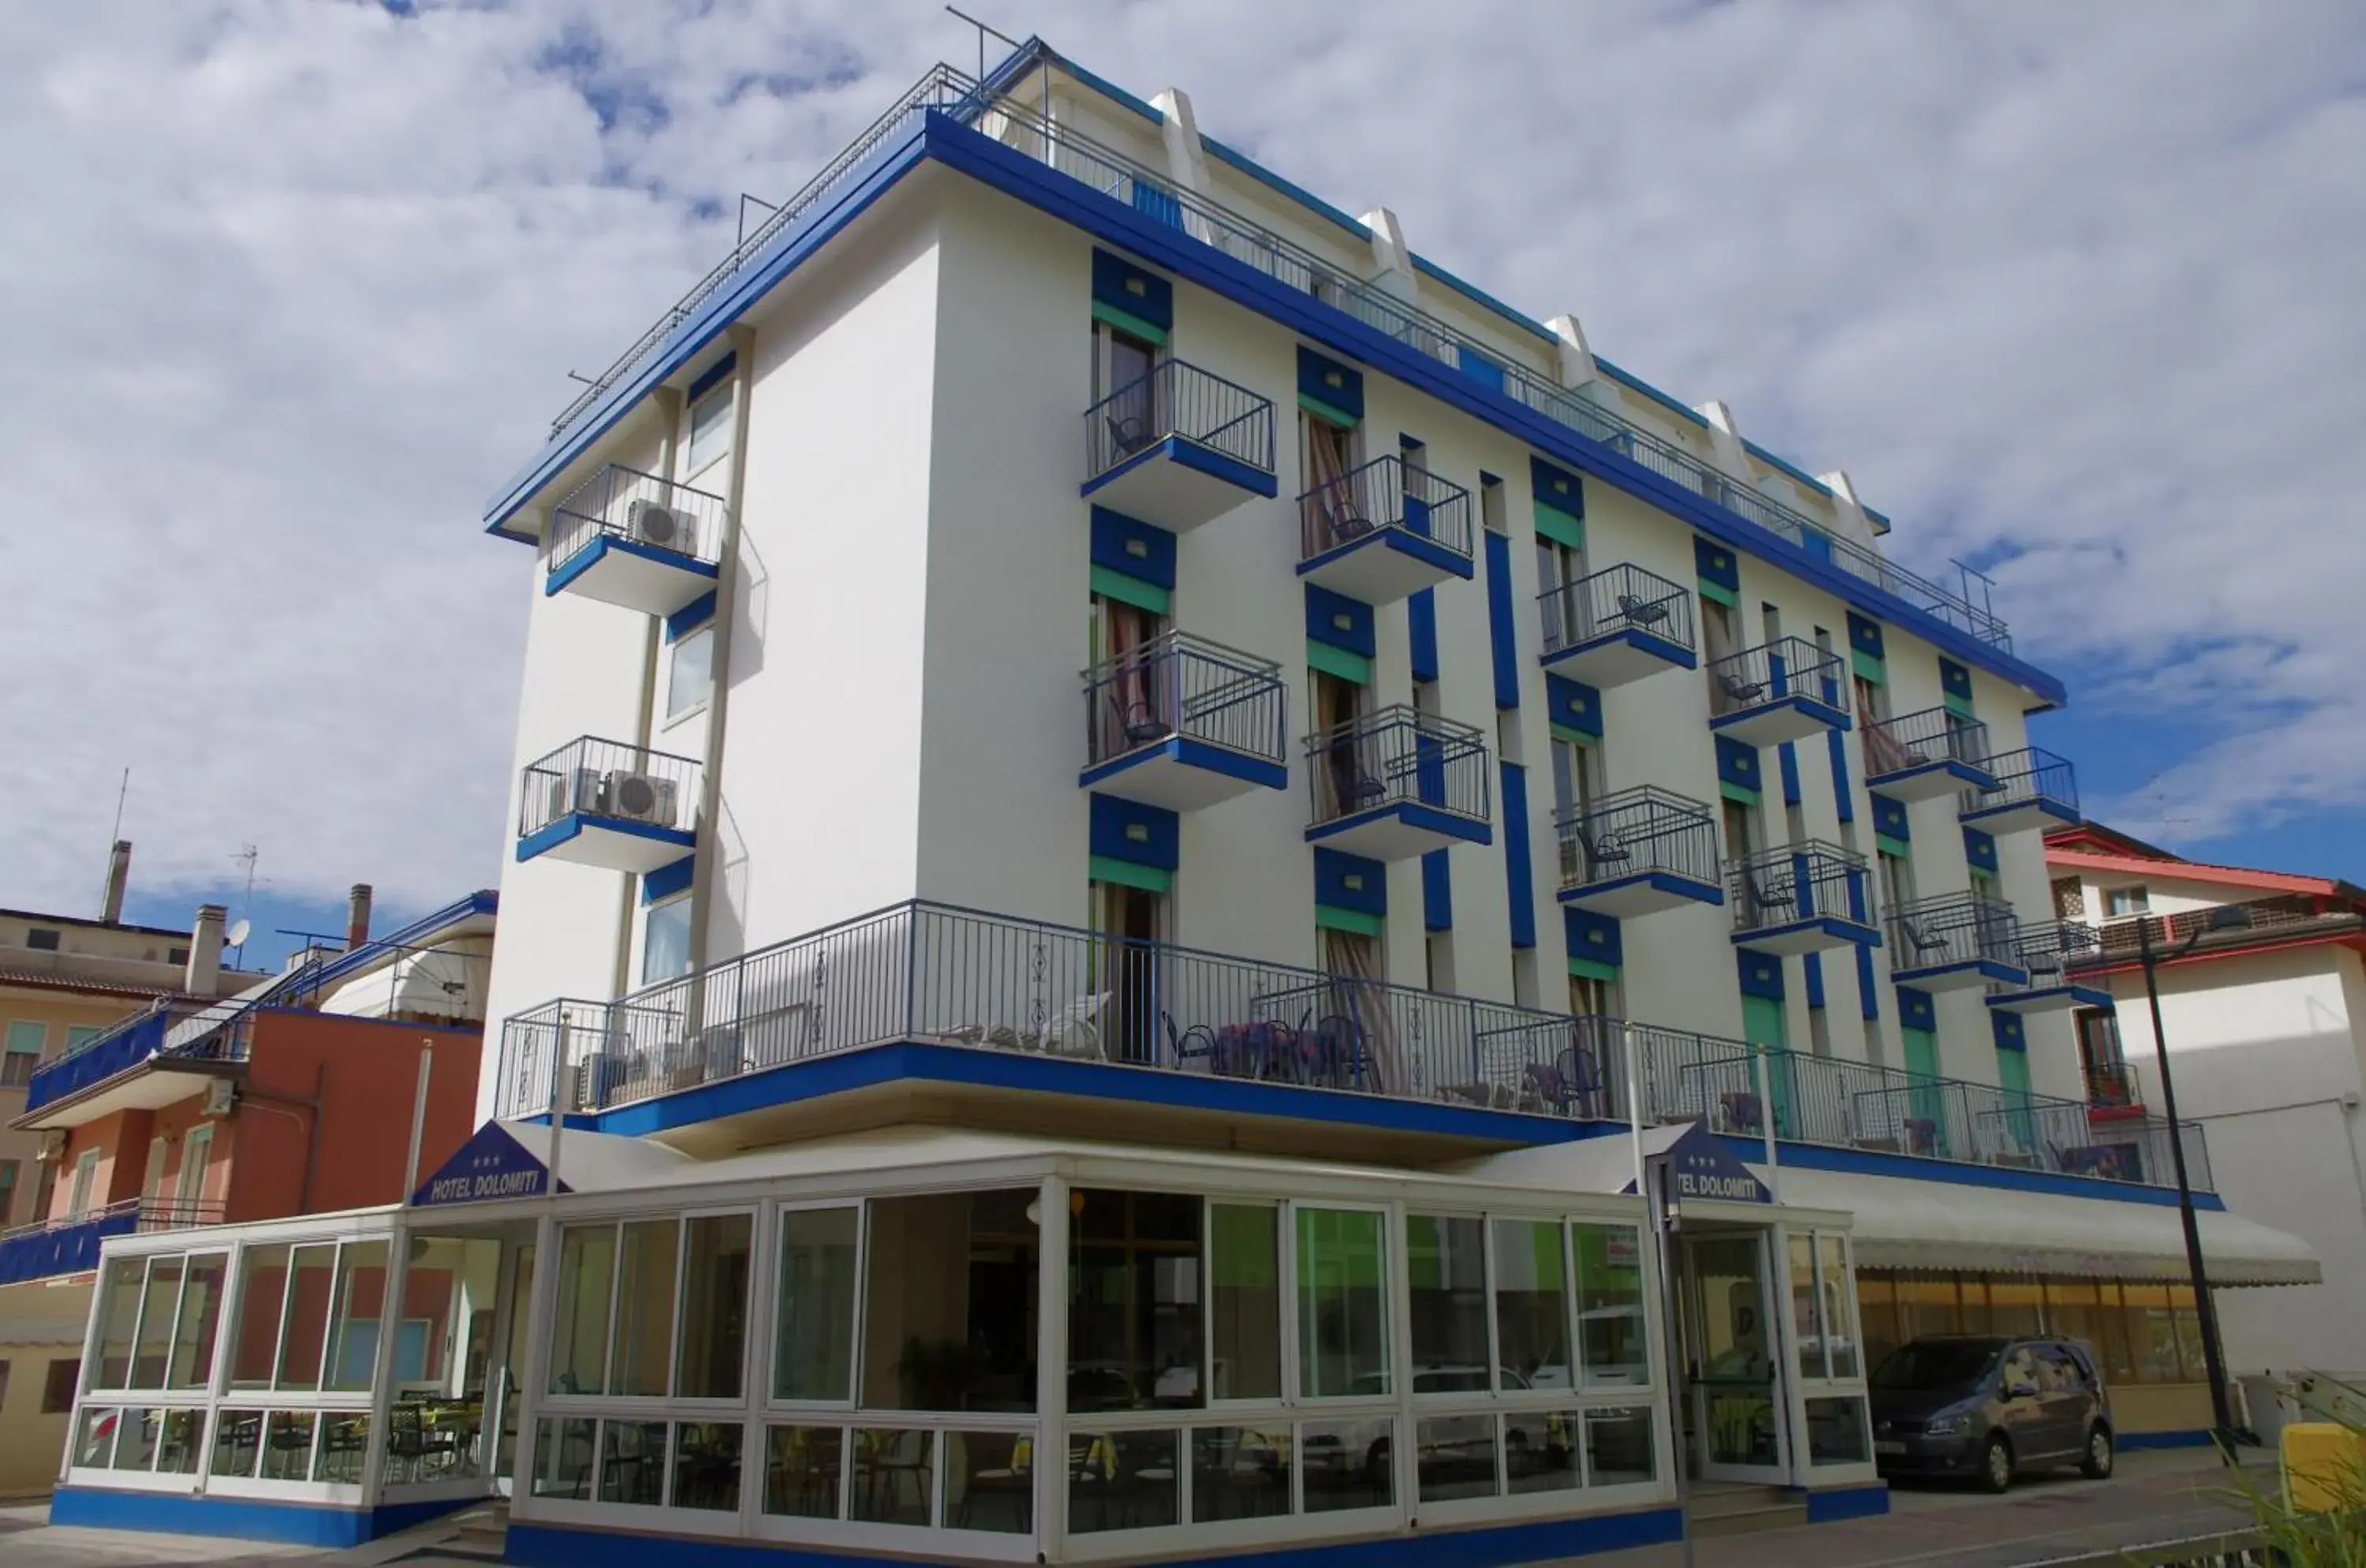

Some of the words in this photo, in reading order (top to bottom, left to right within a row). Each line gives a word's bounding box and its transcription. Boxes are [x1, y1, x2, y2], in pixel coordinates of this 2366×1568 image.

[431, 1178, 471, 1201] HOTEL
[474, 1170, 539, 1197] DOLOMITI
[1677, 1173, 1697, 1193] TEL
[1699, 1175, 1756, 1199] DOLOMITI
